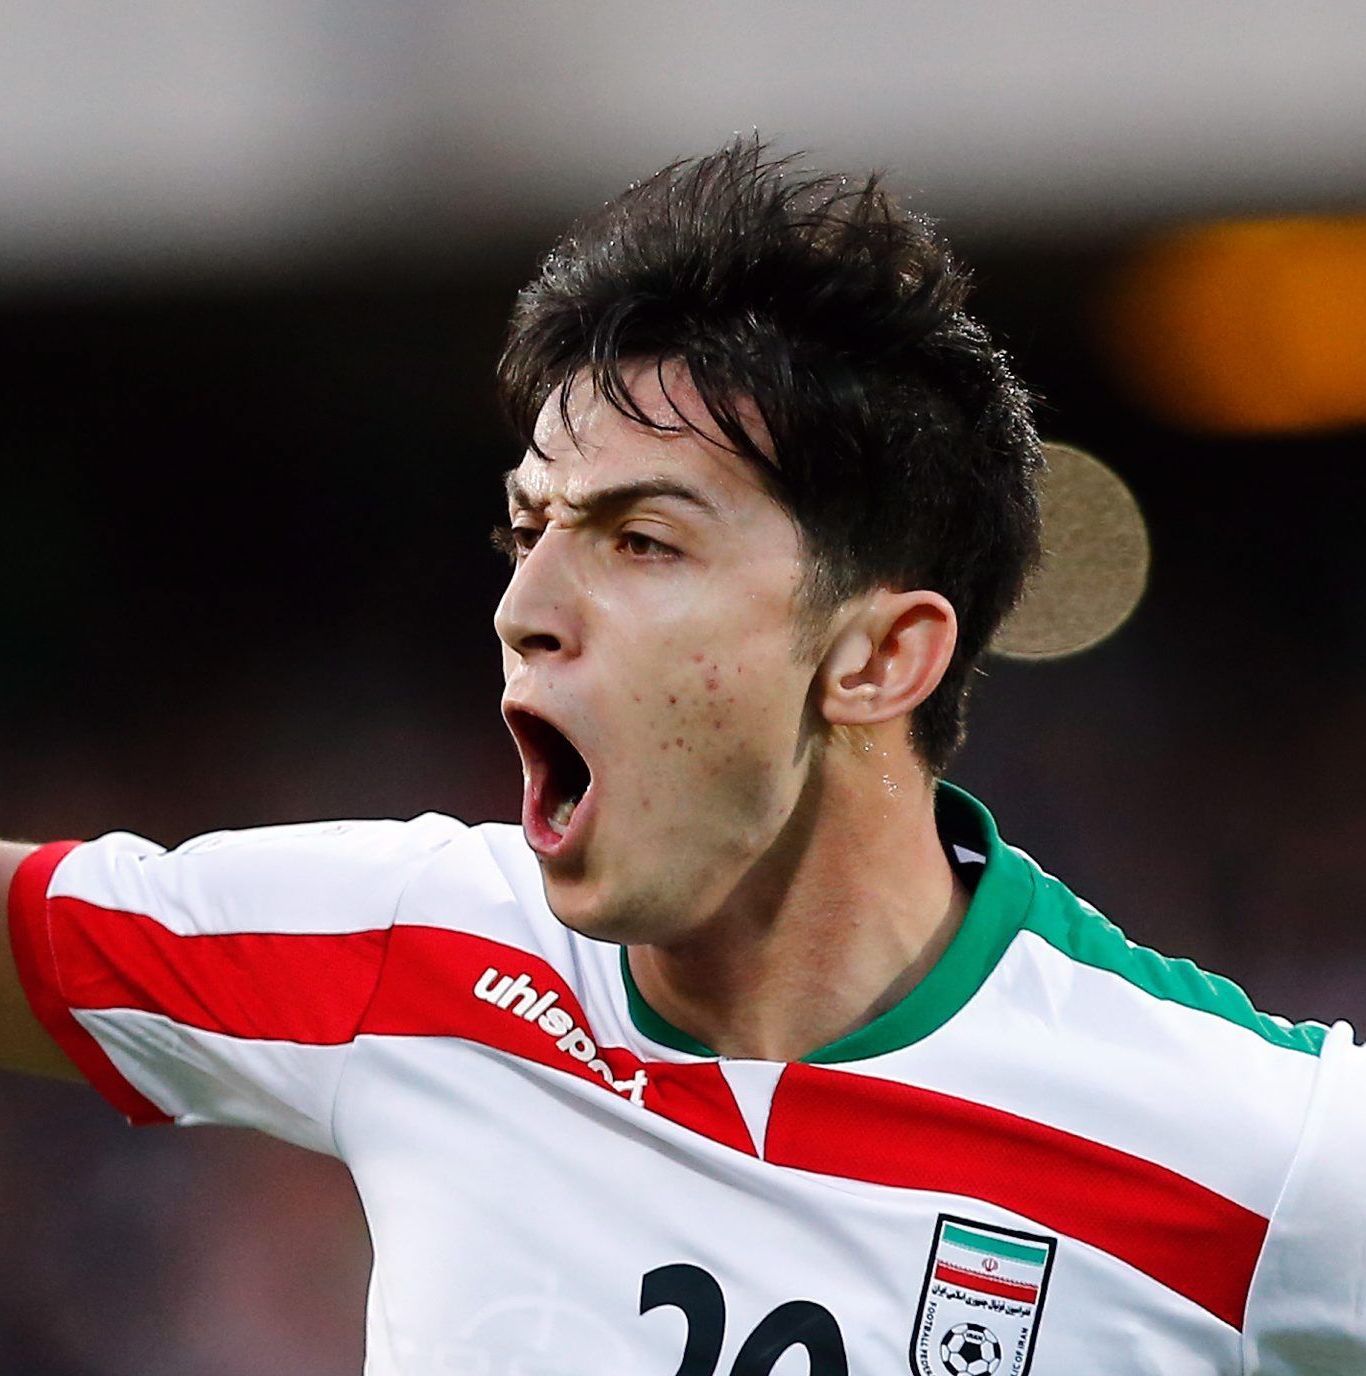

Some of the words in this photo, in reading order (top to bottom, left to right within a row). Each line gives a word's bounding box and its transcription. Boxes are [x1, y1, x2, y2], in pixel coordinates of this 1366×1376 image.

[474, 967, 648, 1108] uhlspt
[920, 1302, 937, 1348] FOOTBALL
[966, 1333, 983, 1341] IRAN
[1018, 1327, 1029, 1350] IRAN
[1014, 1350, 1023, 1363] OF
